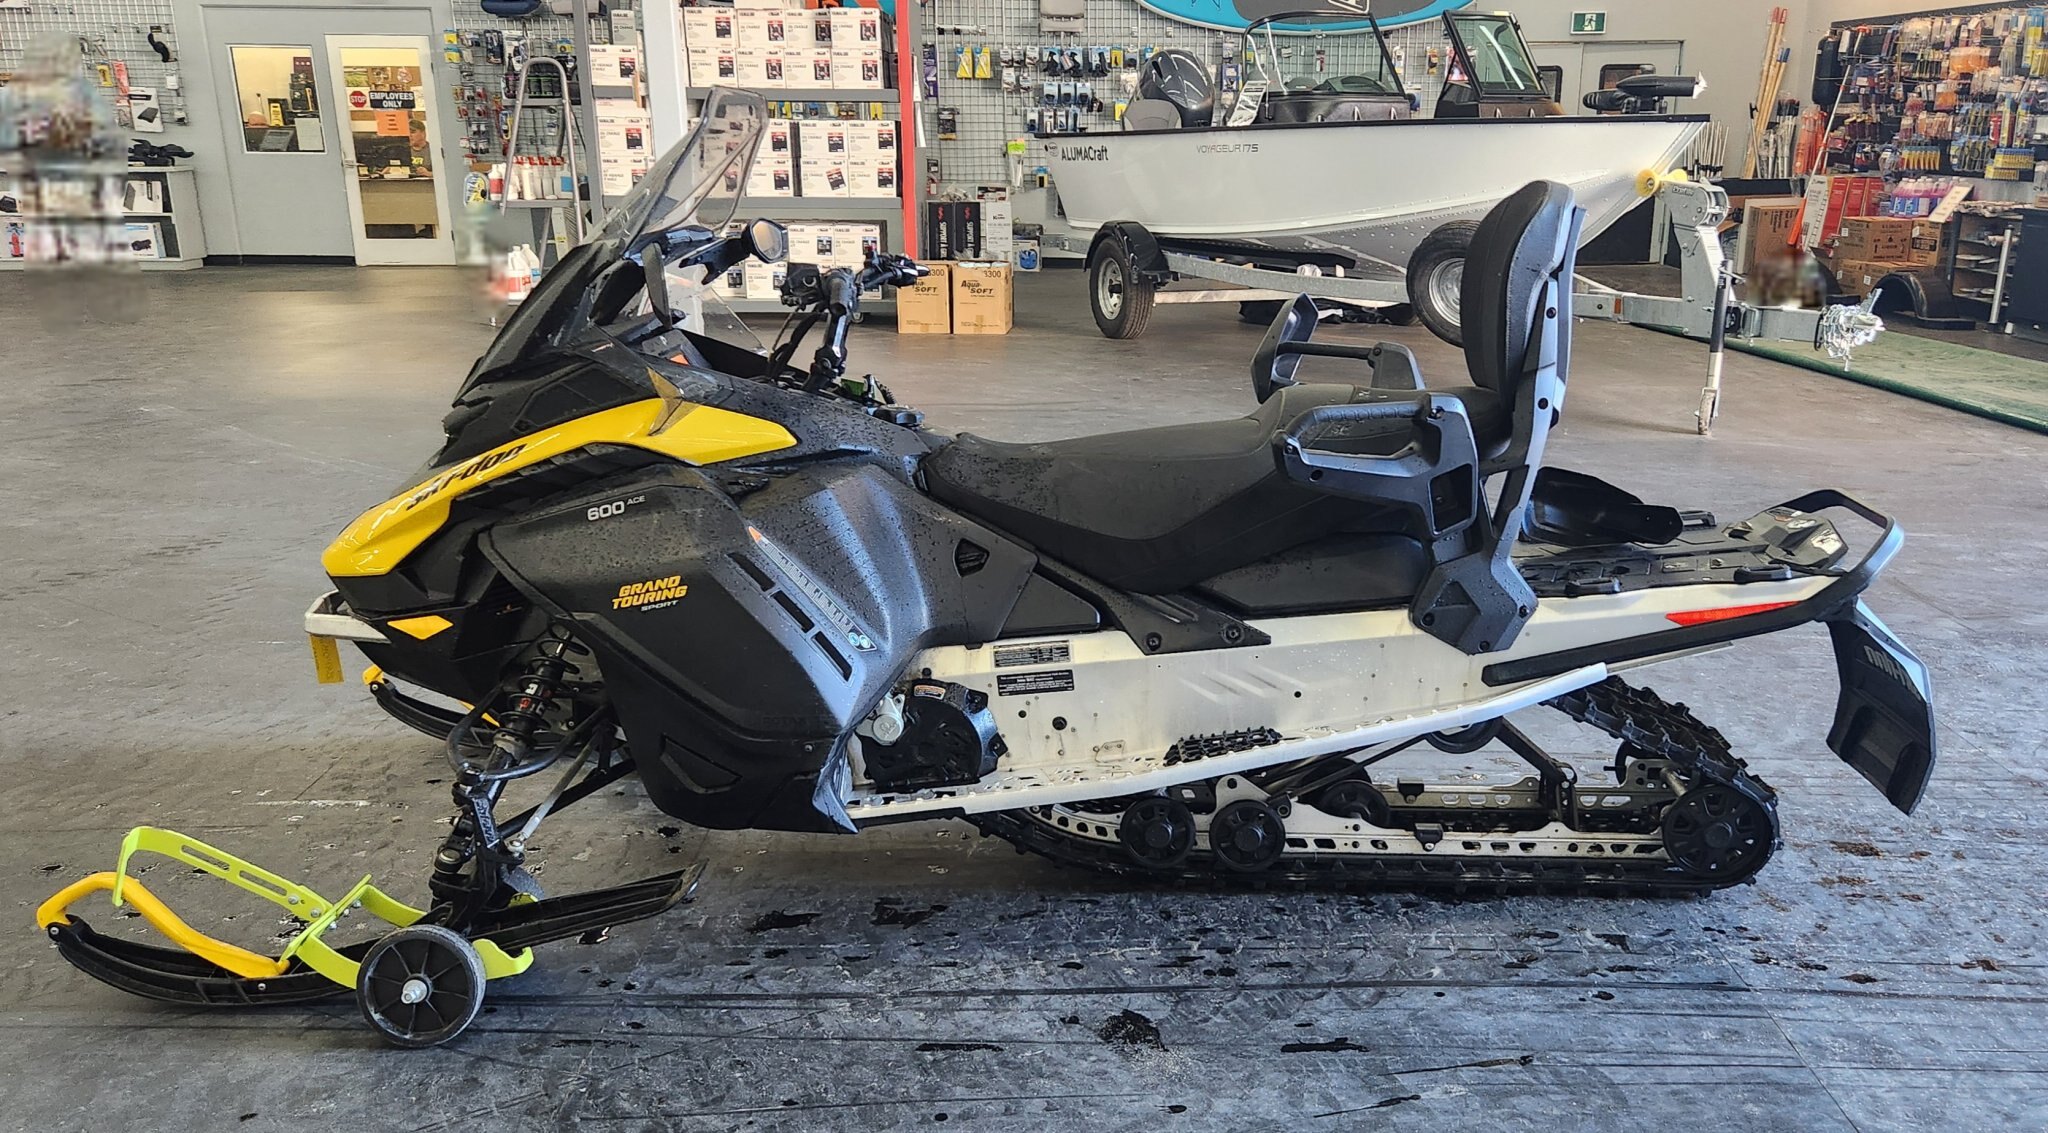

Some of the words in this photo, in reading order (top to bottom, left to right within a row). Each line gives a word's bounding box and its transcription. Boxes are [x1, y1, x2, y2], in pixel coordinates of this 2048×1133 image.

[350, 95, 367, 104] STOP
[1062, 145, 1108, 160] ALUMACraft
[1196, 144, 1241, 153] VOYAGEUR
[1242, 144, 1258, 153] 175
[940, 222, 948, 243] SUPPORT
[587, 500, 624, 521] 600
[626, 496, 646, 505] ACE
[619, 576, 681, 597] GRAND
[612, 585, 688, 609] TOURING
[641, 600, 680, 611] SPORT
